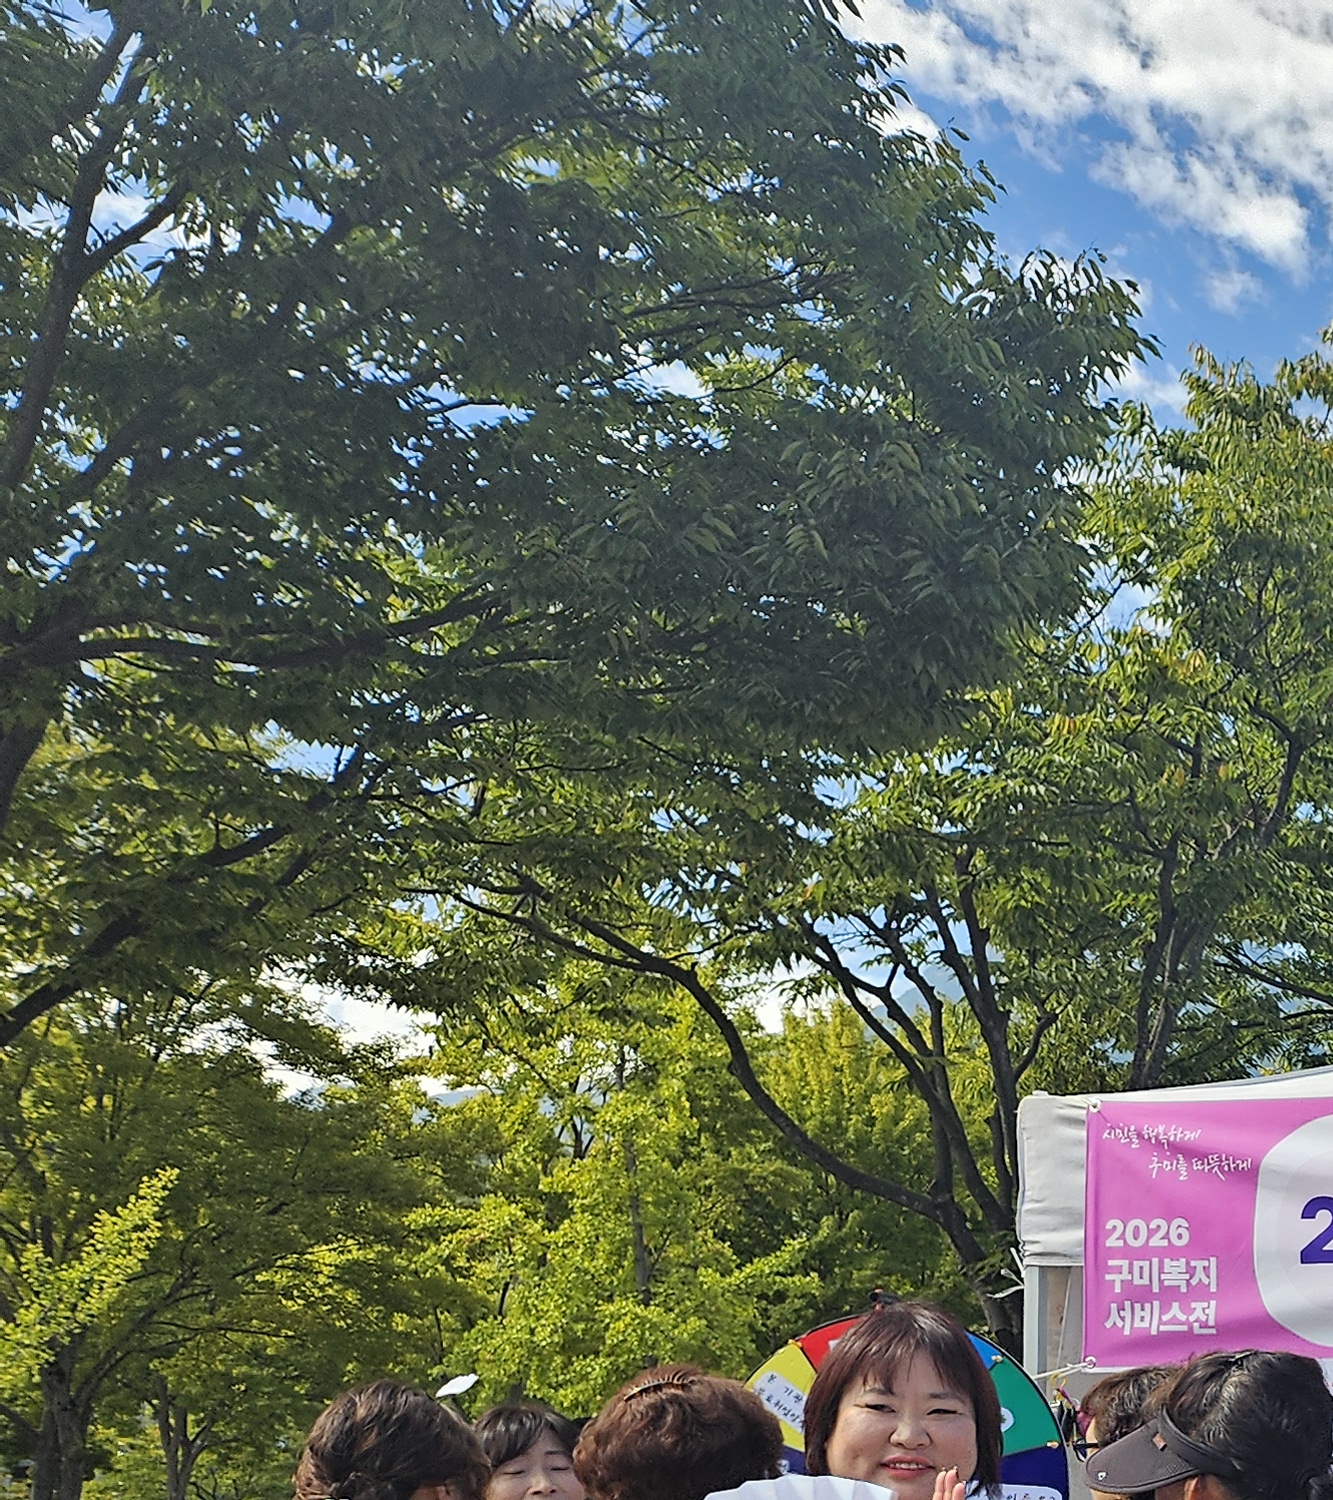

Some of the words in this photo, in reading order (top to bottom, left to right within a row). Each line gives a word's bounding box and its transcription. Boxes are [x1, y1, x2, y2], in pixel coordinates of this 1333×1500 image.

[1102, 1123, 1140, 1148] 시민을
[1142, 1124, 1201, 1149] 행복하게
[1148, 1152, 1188, 1180] 구미를
[1192, 1153, 1252, 1181] 따뜻하게
[1105, 1217, 1190, 1247] 2026
[1104, 1257, 1217, 1293] 구미복지
[1104, 1300, 1217, 1335] 서비스전
